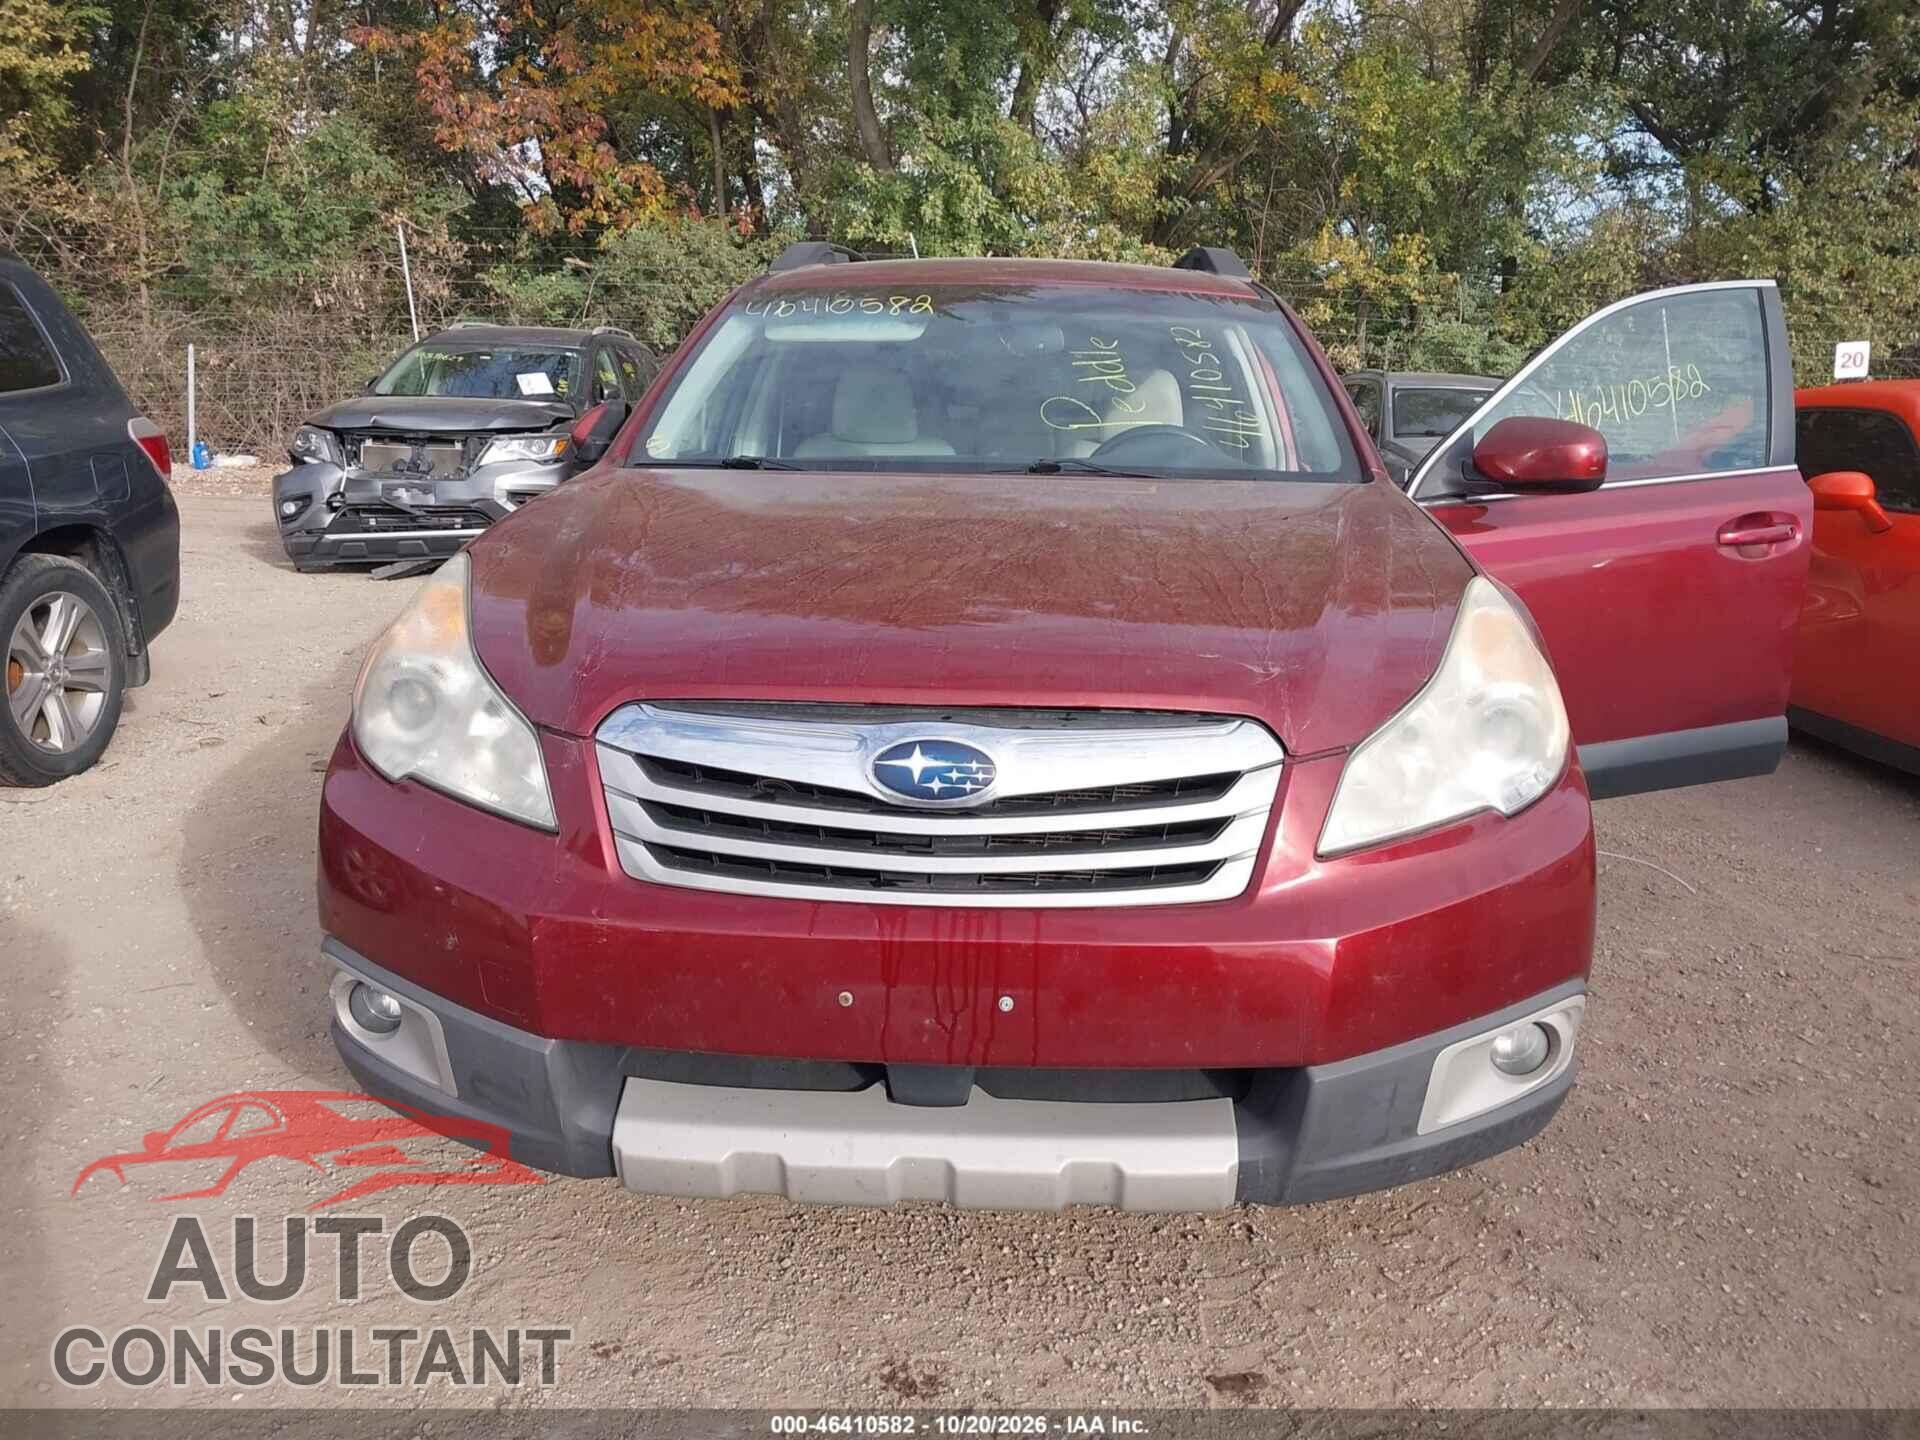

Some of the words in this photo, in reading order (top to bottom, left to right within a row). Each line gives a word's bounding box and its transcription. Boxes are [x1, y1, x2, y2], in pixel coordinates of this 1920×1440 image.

[745, 295, 934, 318] 46410582
[1840, 351, 1864, 369] 20
[1170, 326, 1263, 449] 46410582
